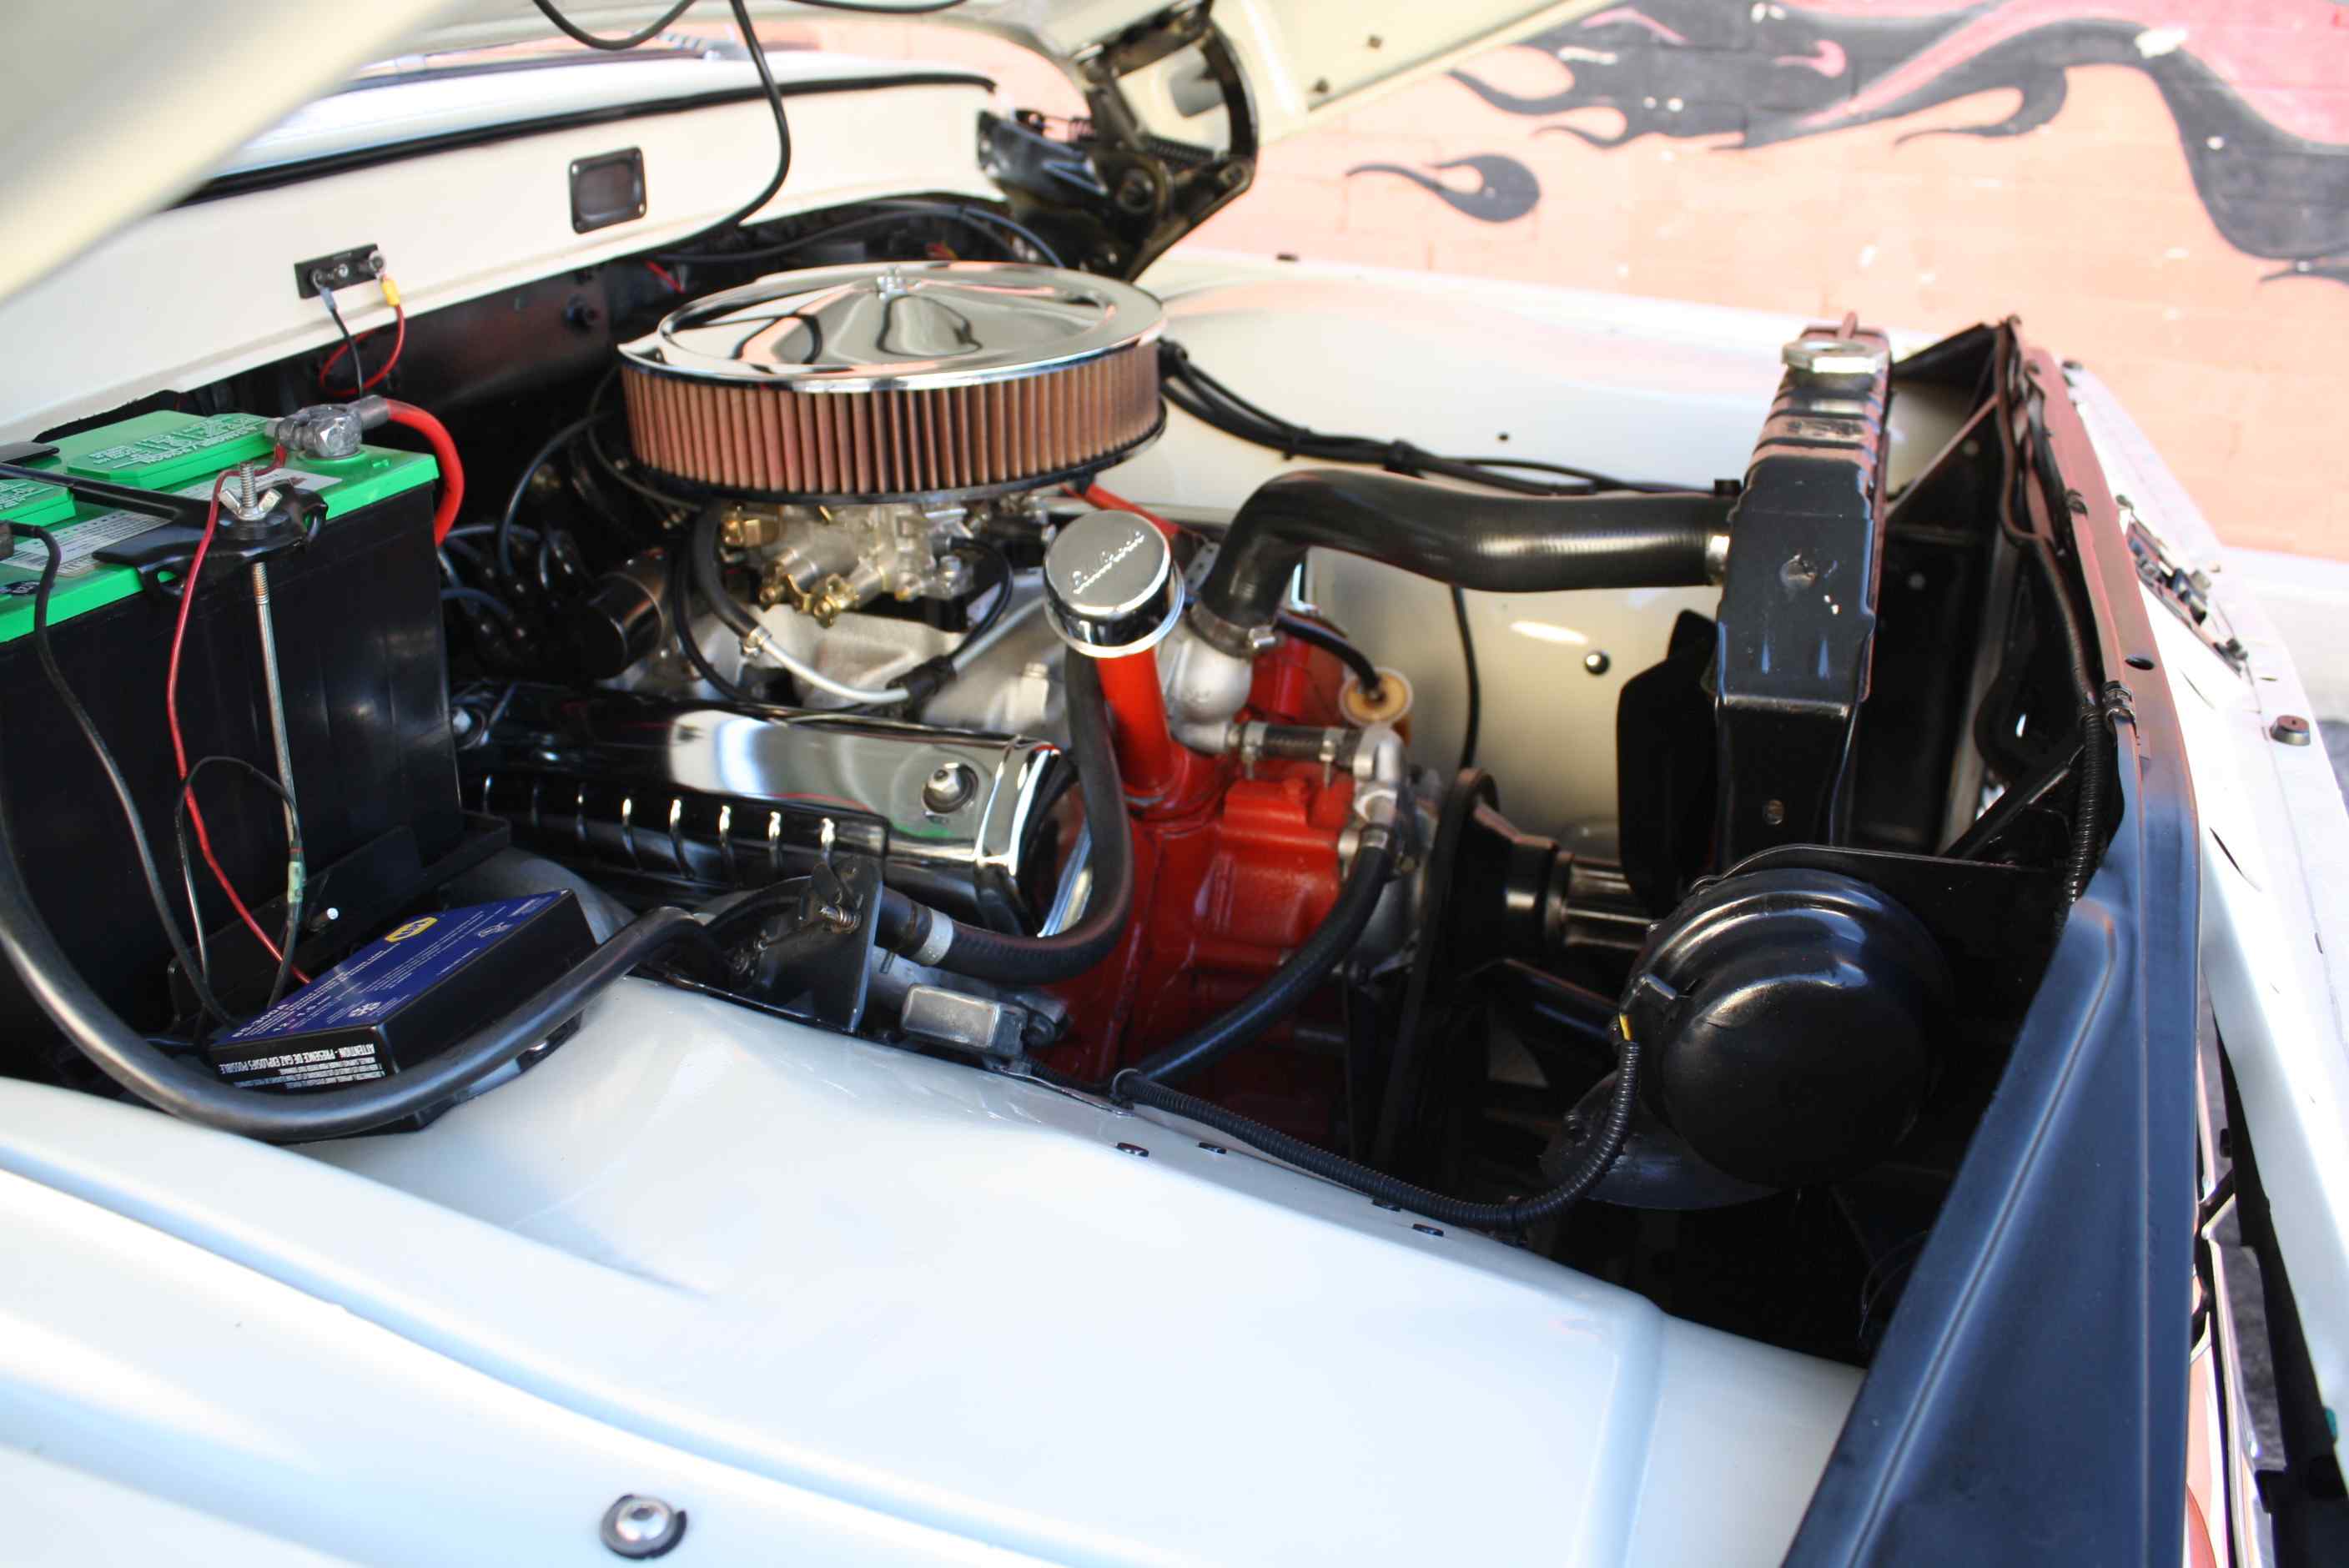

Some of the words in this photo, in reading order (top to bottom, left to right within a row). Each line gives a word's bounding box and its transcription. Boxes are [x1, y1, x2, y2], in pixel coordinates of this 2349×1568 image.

[338, 1043, 375, 1059] ATTENTION
[279, 1053, 294, 1067] GAZ
[292, 1053, 304, 1064] DE
